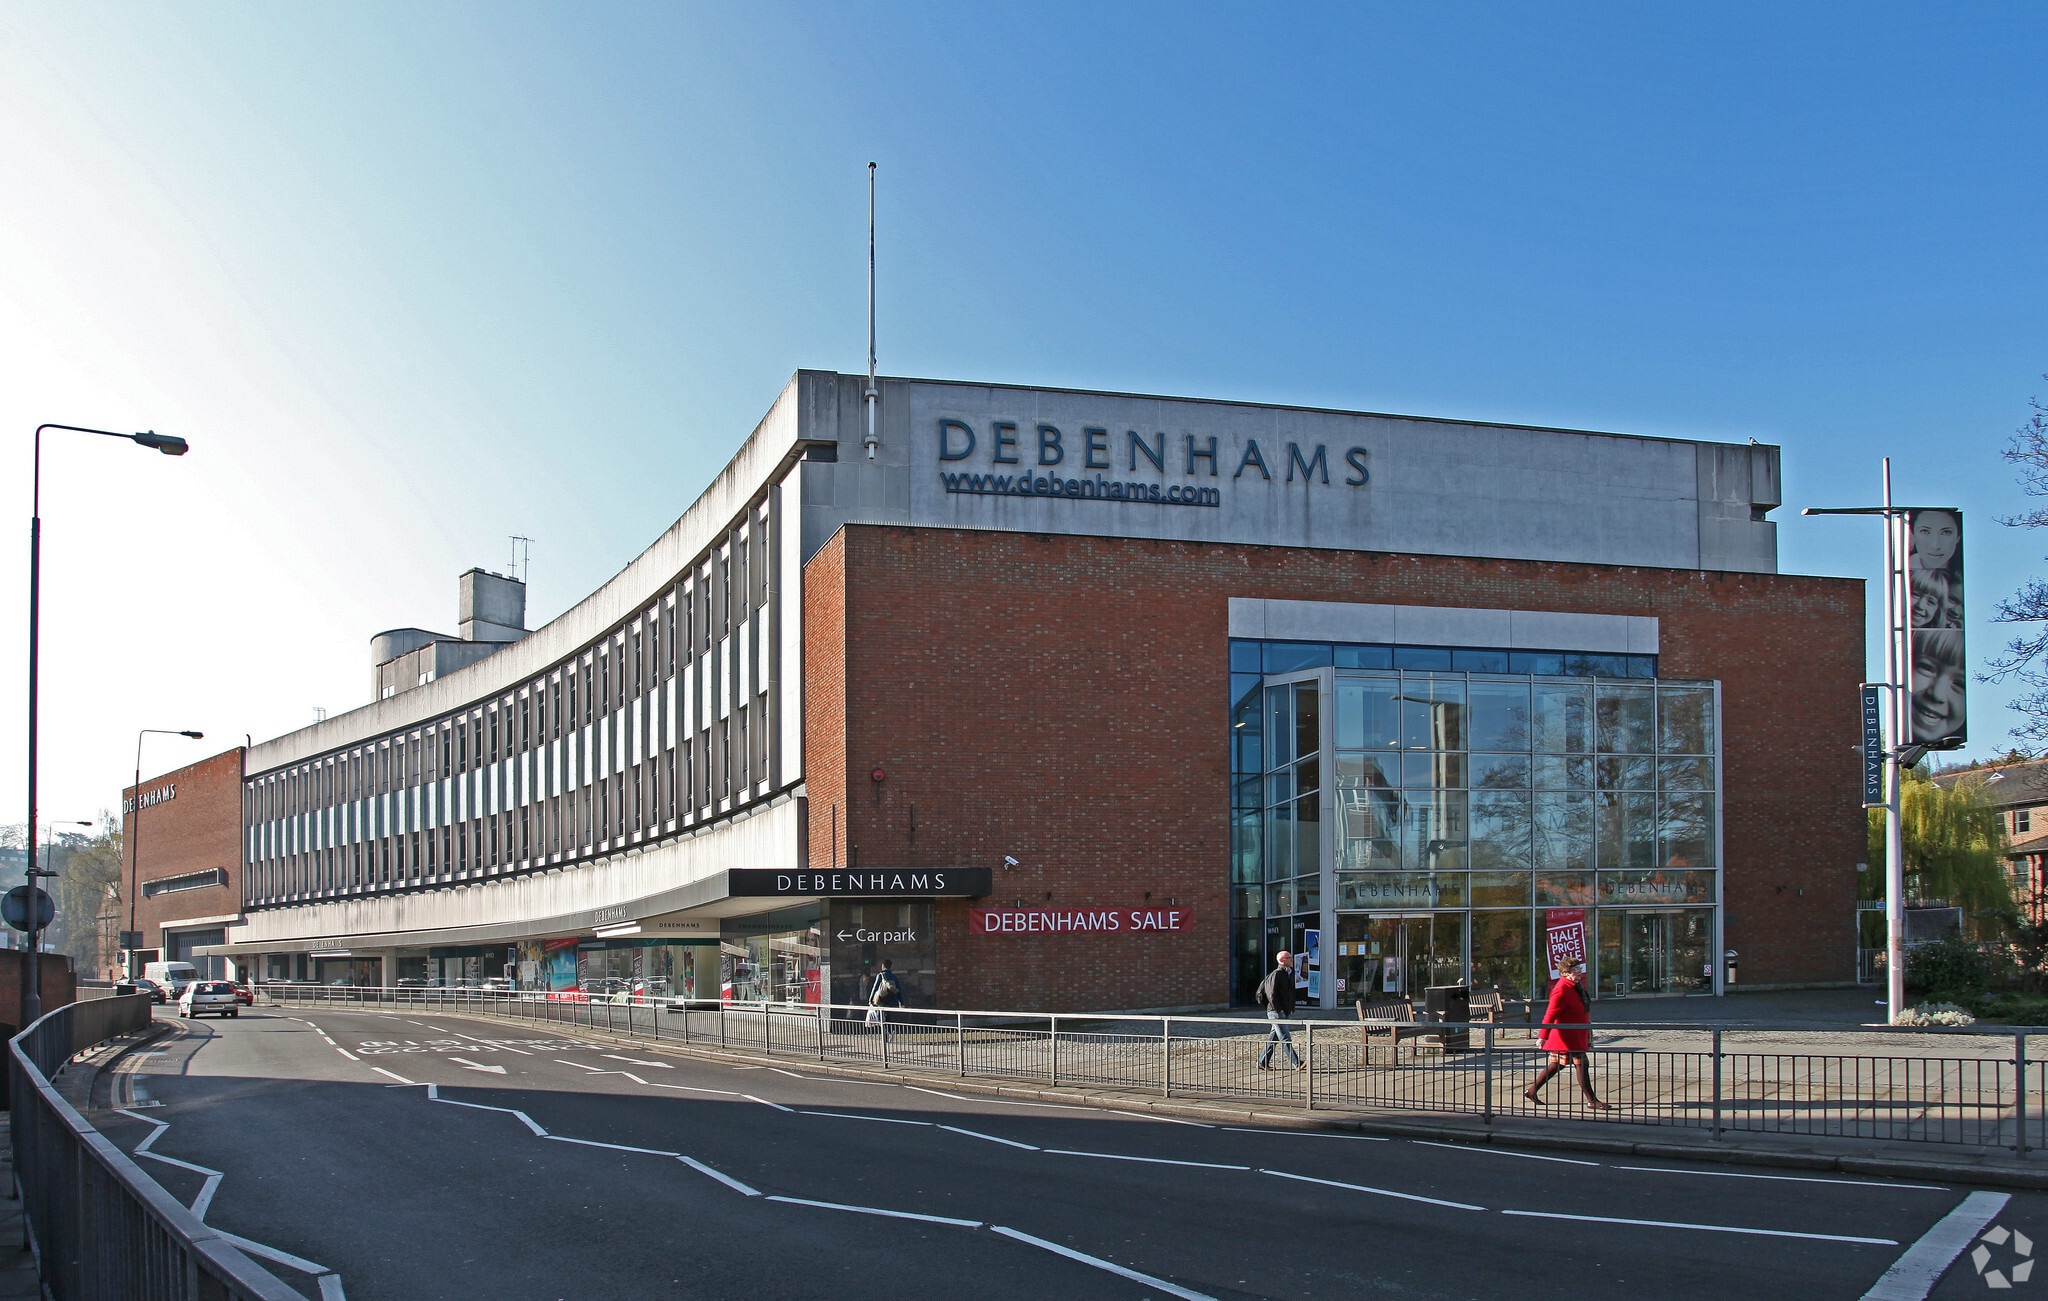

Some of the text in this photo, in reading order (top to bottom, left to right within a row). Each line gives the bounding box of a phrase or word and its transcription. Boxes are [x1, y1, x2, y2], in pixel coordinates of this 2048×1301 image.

[939, 418, 1370, 486] DEBENHAMS
[940, 470, 1220, 505] www.debenhams.com
[1865, 696, 1878, 795] DEBENHAMS
[123, 784, 177, 814] DEENHAMS
[776, 873, 947, 892] DEBENHAMS
[1605, 881, 1708, 896] DEBENHA
[594, 906, 627, 922] DEBENHAMS
[984, 911, 1181, 933] DEBENHAMS SALE
[312, 940, 343, 949] DEENHAS
[855, 928, 916, 945] Car park
[1549, 927, 1578, 944] HALF
[1552, 939, 1580, 954] PRICE
